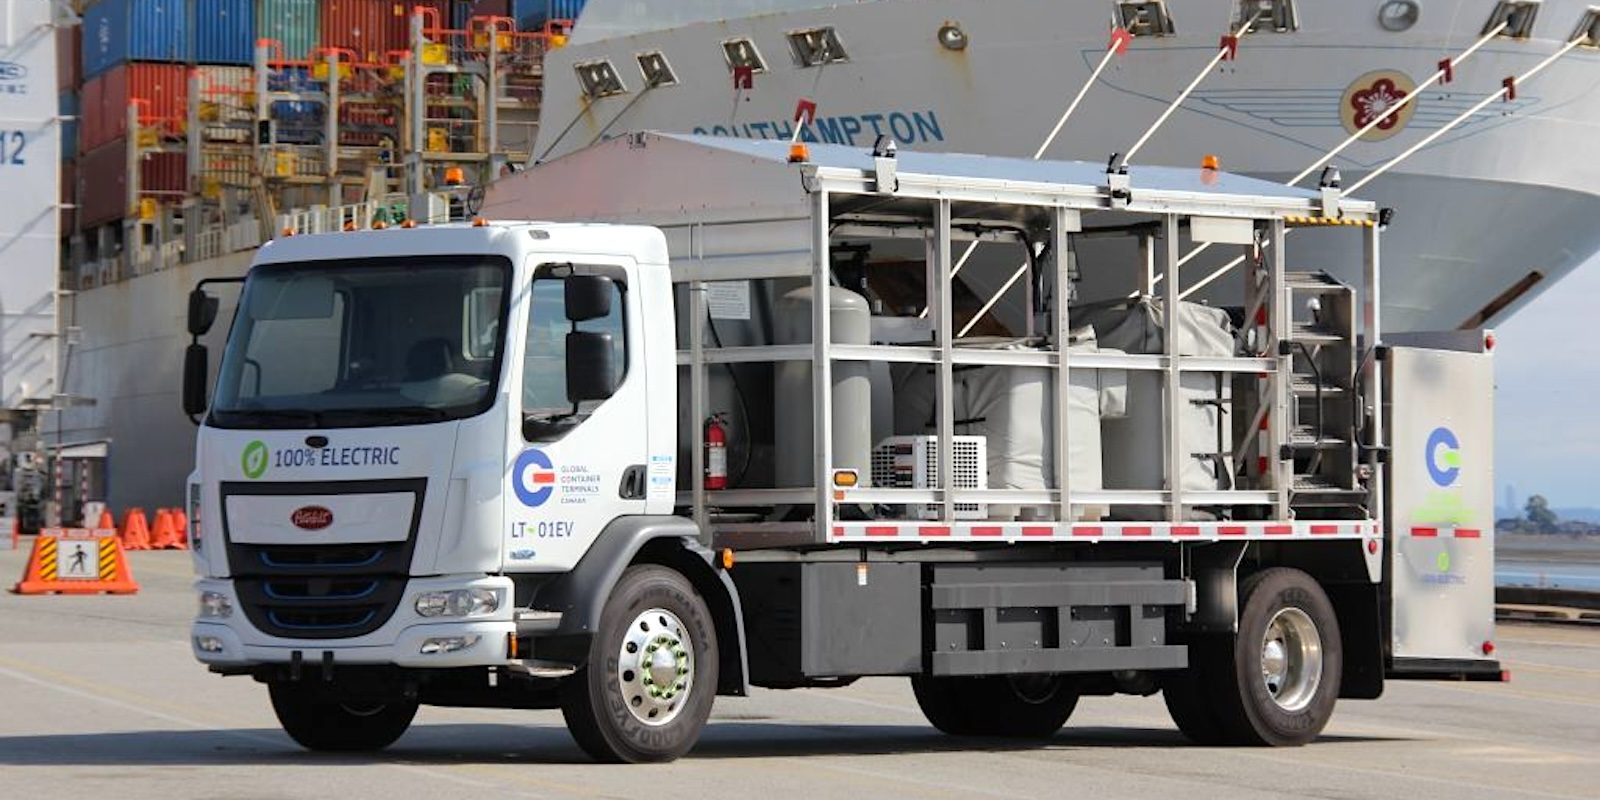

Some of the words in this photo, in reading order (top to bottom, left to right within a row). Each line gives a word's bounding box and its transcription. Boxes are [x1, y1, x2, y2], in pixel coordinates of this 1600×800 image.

[692, 108, 945, 146] THAMPTON
[275, 449, 316, 468] 100%
[321, 446, 400, 467] ELECTRIC
